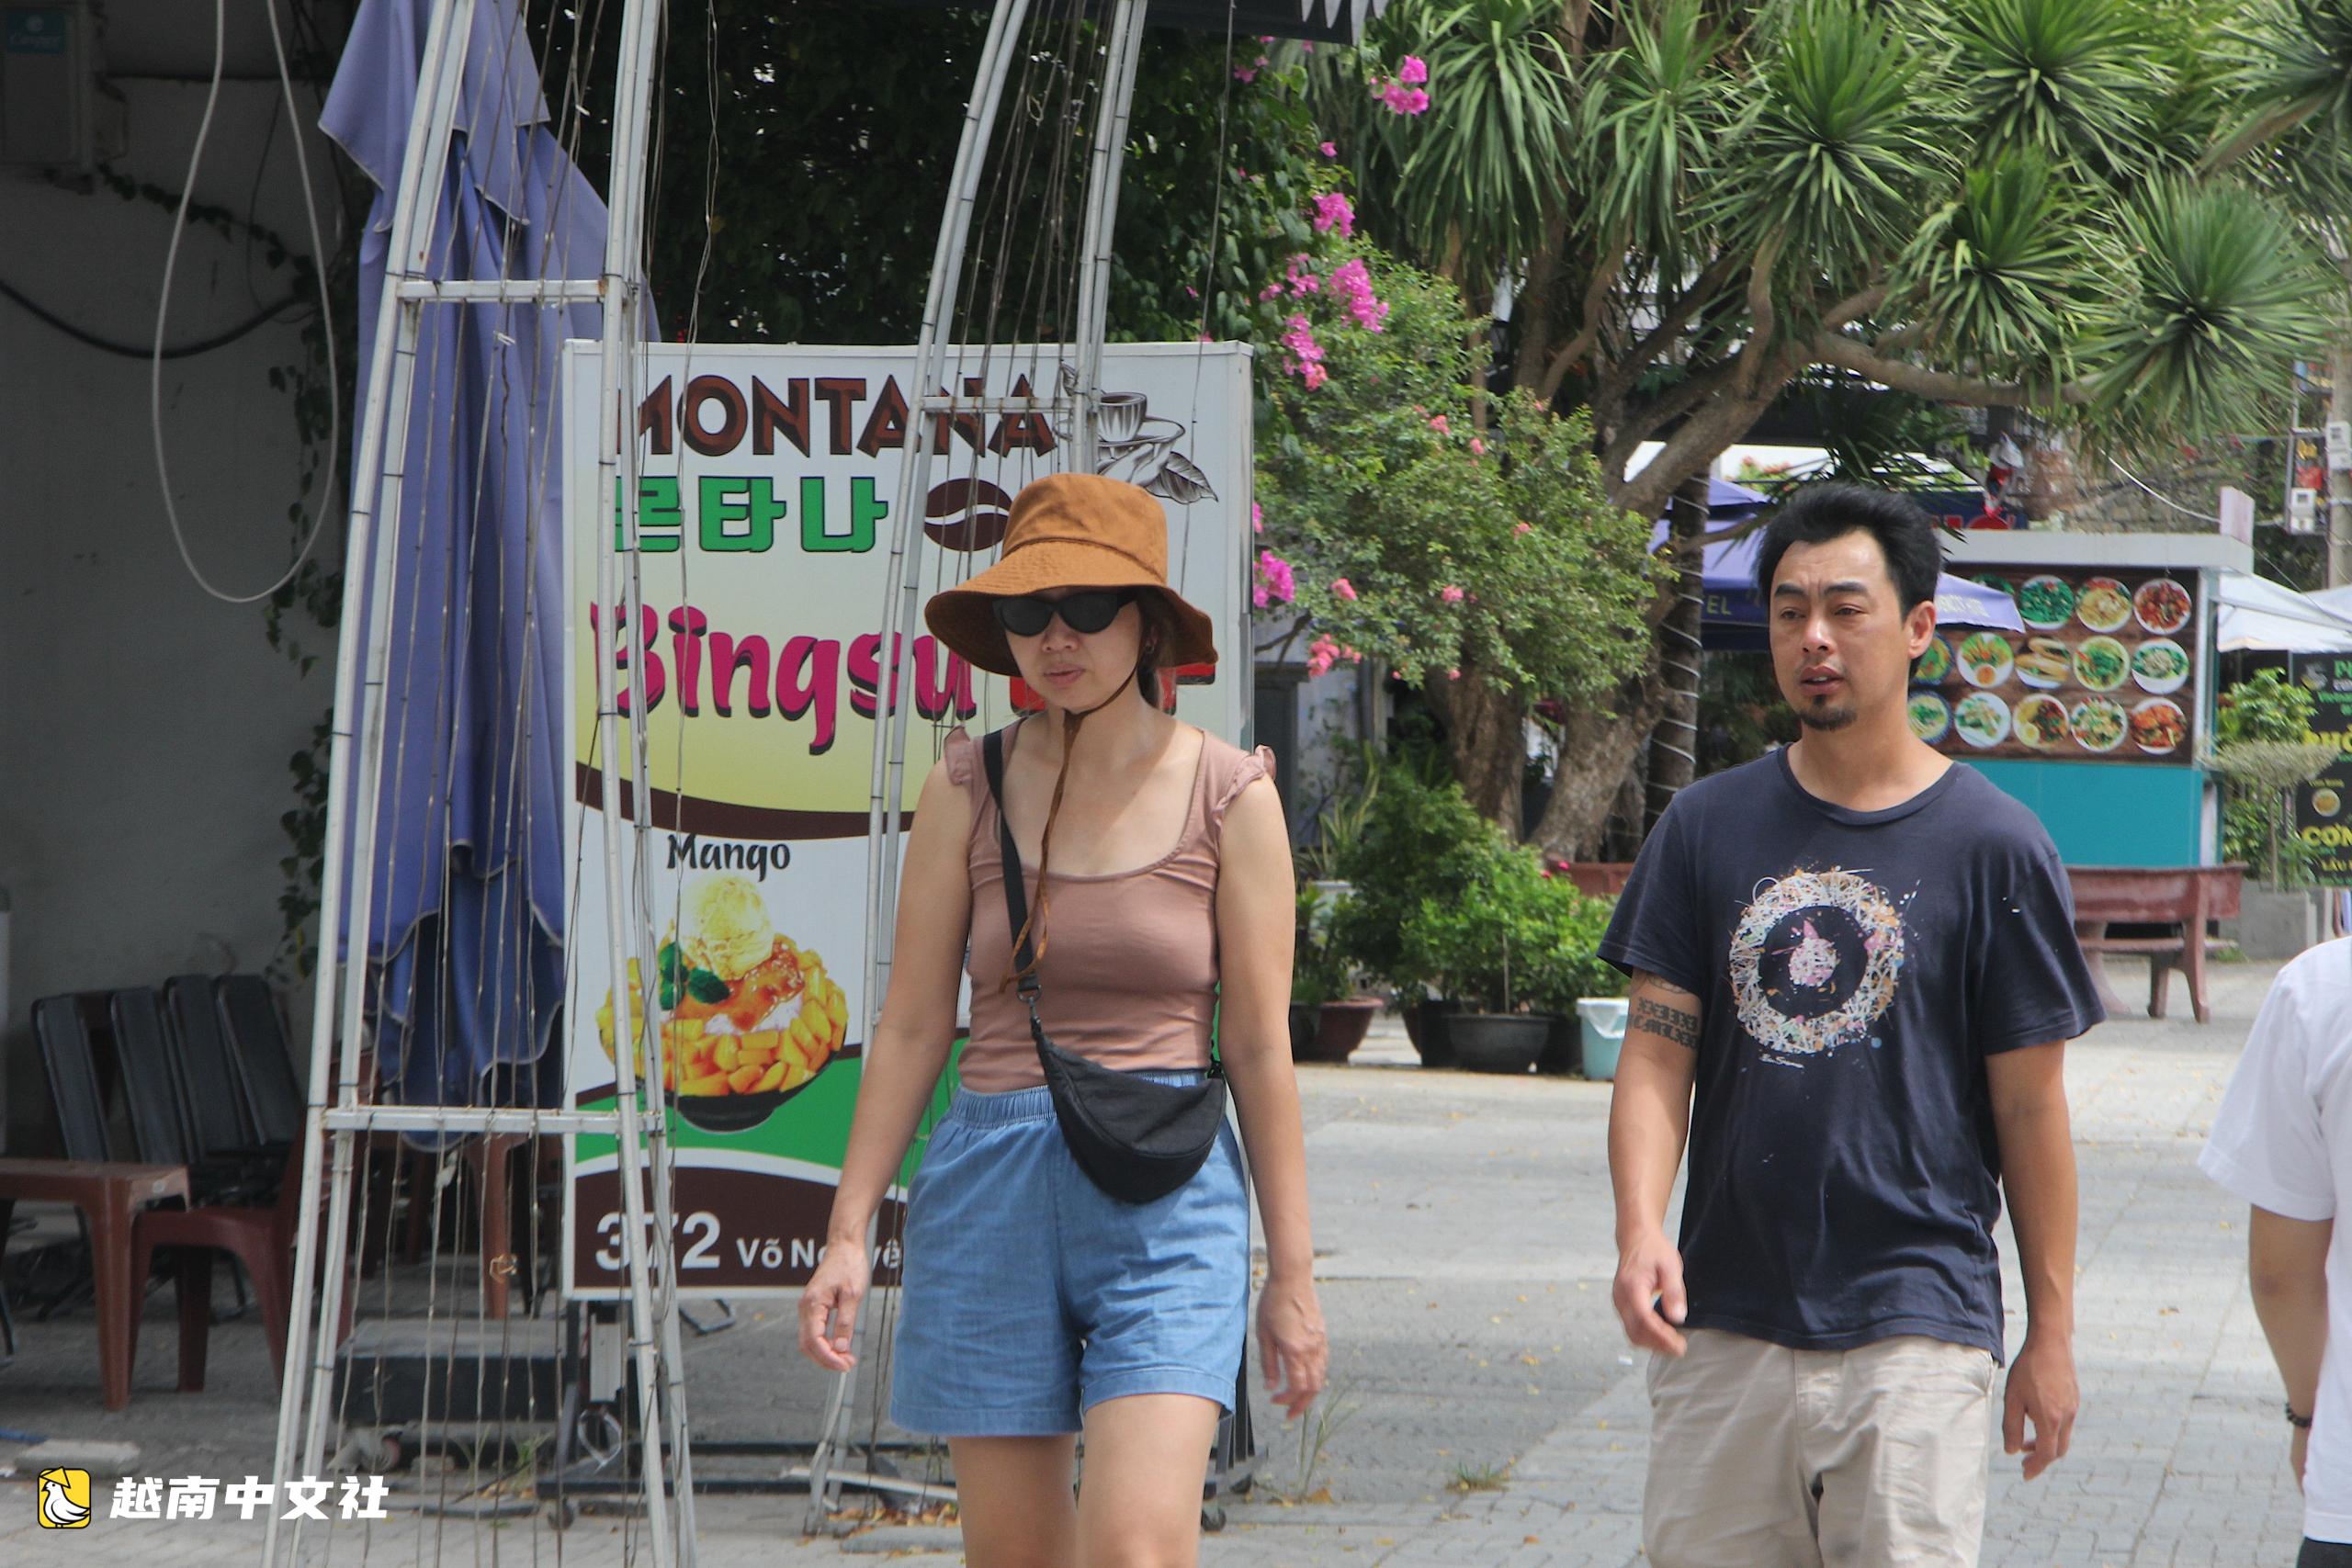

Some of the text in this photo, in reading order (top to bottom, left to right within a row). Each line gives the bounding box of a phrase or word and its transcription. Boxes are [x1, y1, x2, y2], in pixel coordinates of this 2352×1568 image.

[591, 602, 976, 755] Bingsu
[667, 834, 790, 882] Mango
[736, 1237, 784, 1269] Võ
